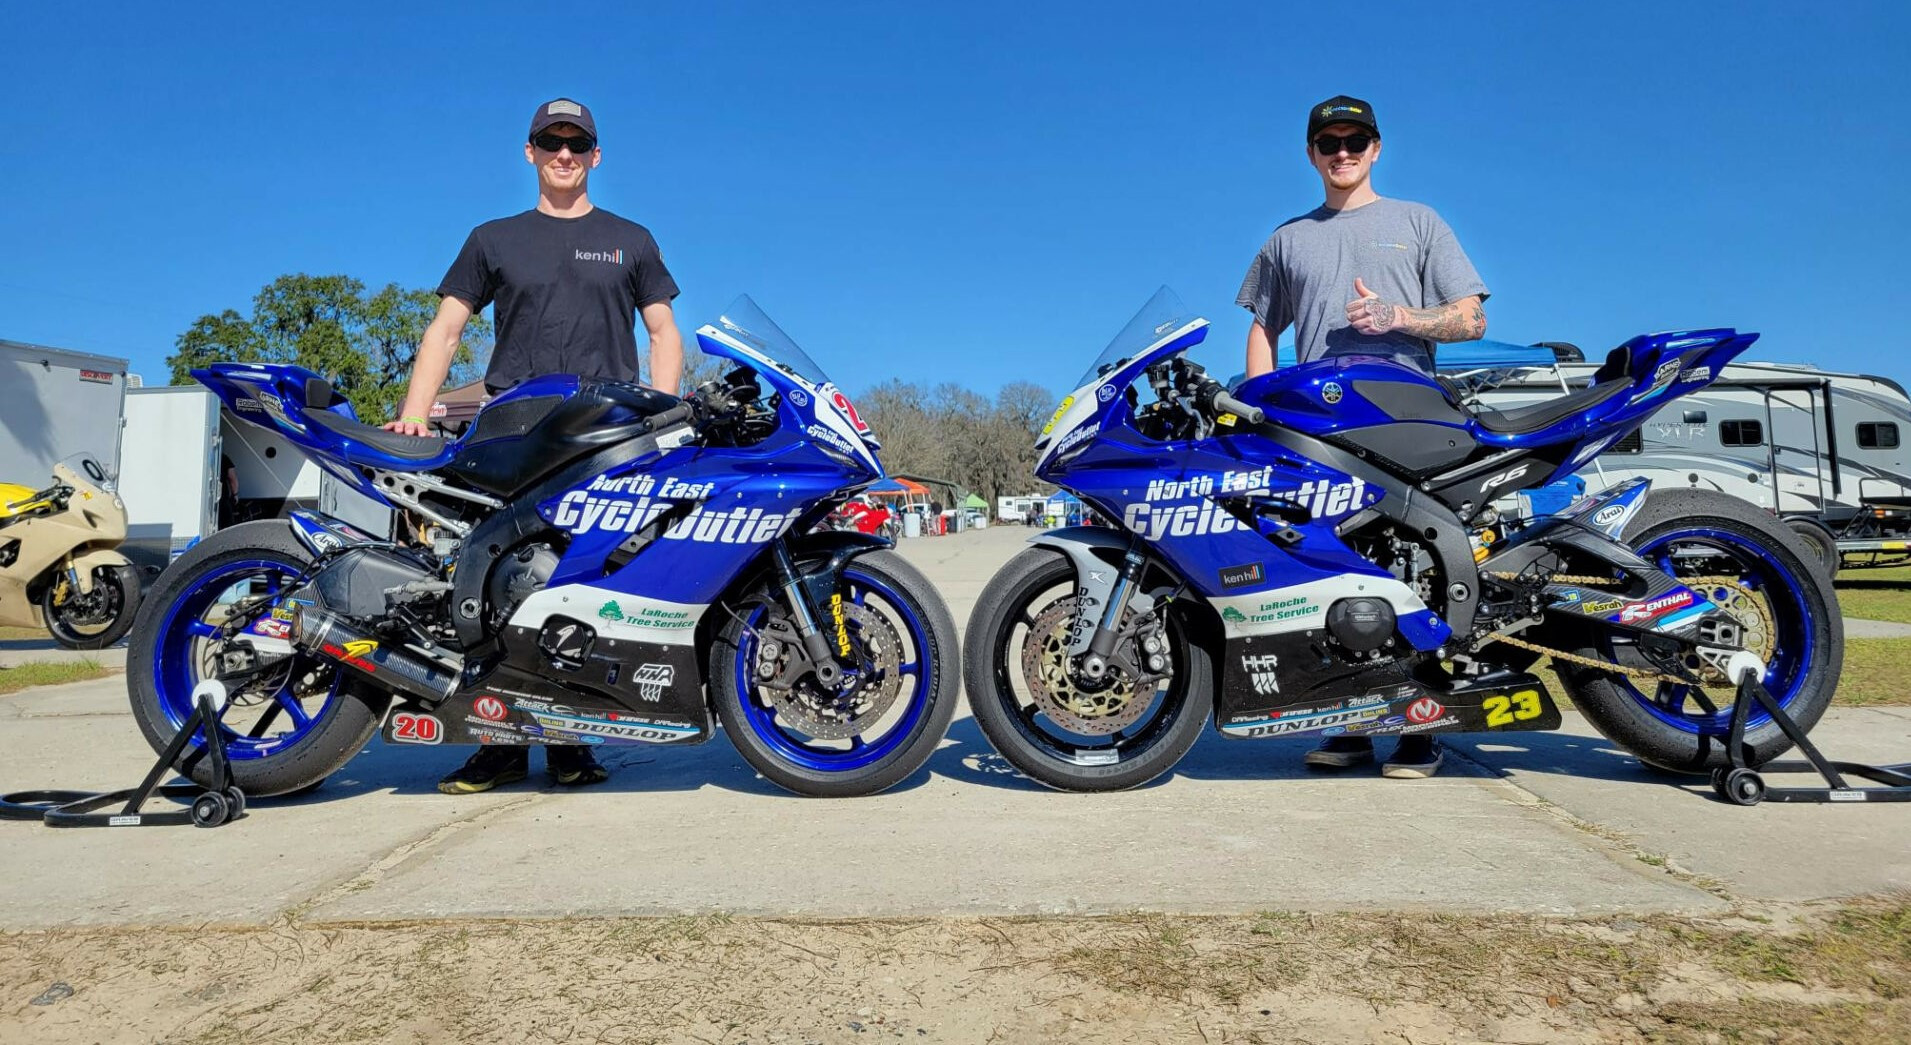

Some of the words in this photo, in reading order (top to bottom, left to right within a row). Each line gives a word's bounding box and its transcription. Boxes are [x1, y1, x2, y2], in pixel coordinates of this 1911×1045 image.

[575, 249, 601, 261] ken
[603, 249, 623, 265] hill
[657, 477, 716, 501] East
[1145, 474, 1214, 502] North
[1221, 465, 1274, 494] East
[1600, 507, 1623, 523] Arai
[1223, 573, 1245, 585] ken
[1247, 565, 1261, 581] hill
[641, 608, 689, 619] LaRoche
[1250, 613, 1275, 623] Tree
[1277, 604, 1320, 620] Service
[1260, 597, 1308, 612] LaRoche
[1582, 599, 1624, 615] Vesrah
[1620, 592, 1692, 622] RENTHAL
[626, 616, 651, 627] Tree
[652, 619, 695, 628] Service
[831, 594, 851, 657] DUNLOP
[1071, 587, 1090, 646] DUNLOP
[1241, 654, 1278, 673] HHR
[1482, 689, 1543, 728] 23
[395, 713, 437, 741] 20
[571, 721, 677, 741] DUNLOP
[1247, 711, 1361, 737] DUNLOP
